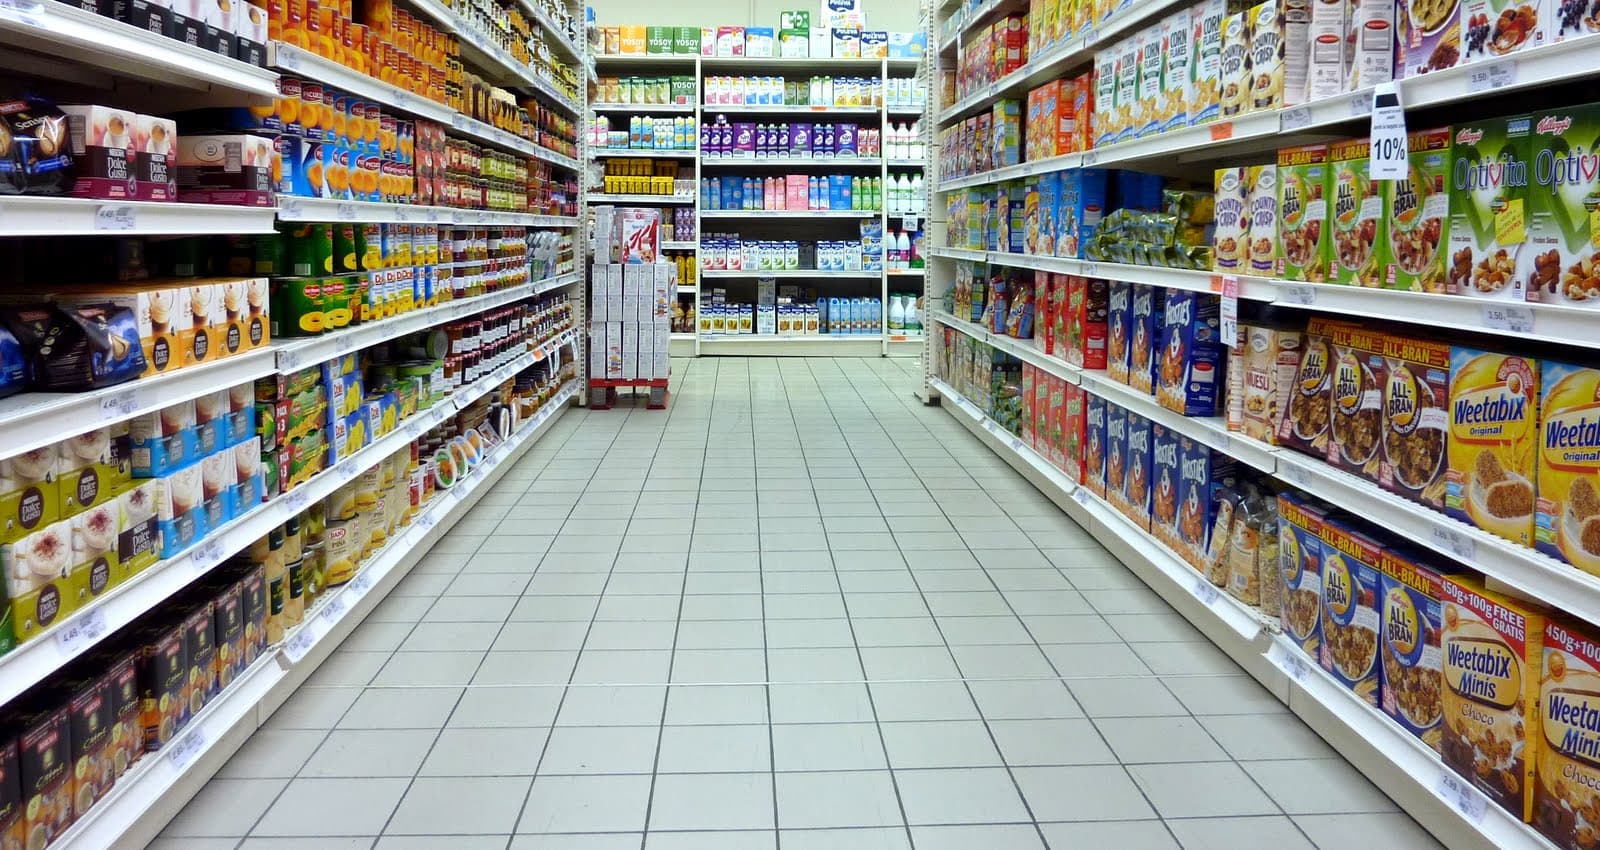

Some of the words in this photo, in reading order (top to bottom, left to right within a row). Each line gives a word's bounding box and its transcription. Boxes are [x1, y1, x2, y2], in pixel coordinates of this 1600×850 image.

[649, 38, 672, 46] YOSOY
[676, 38, 699, 46] YOSOY
[1170, 28, 1187, 44] CORN
[1144, 40, 1160, 56] CORN
[1170, 45, 1187, 57] FLAKES
[1255, 46, 1274, 66] CRISP
[1224, 57, 1240, 74] CRISP
[673, 81, 696, 89] YOSOY
[1374, 138, 1405, 161] 10%
[107, 157, 128, 170] Dolce
[150, 162, 168, 174] Dolce
[1535, 146, 1600, 196] Optiv
[108, 168, 128, 179] Gusto
[1454, 152, 1526, 199] Optivita
[1338, 184, 1355, 199] ALL-
[1336, 197, 1355, 219] BRAN
[1394, 194, 1417, 218] BRAN
[1305, 353, 1324, 368] ALL-
[1382, 341, 1430, 363] ALL-BRAN
[1338, 367, 1358, 384] ALL-
[1336, 382, 1358, 400] BRAN
[1391, 381, 1412, 399] ALL-
[1389, 398, 1413, 417] BRAN
[1454, 393, 1526, 425] Weetabix
[1470, 424, 1503, 437] Original
[80, 481, 97, 493] Dolce
[22, 502, 40, 516] Dolce
[22, 510, 40, 522] Gusto
[133, 529, 150, 547] Dolce
[1320, 527, 1362, 560] ALL-BRAN
[1327, 571, 1346, 590] ALL-
[1380, 557, 1431, 595] ALL-BRAN
[40, 598, 57, 613] Dolce
[1326, 586, 1347, 607] BRAN
[1441, 580, 1493, 619] 450g+100g
[1493, 604, 1524, 629] FREE
[1389, 605, 1412, 626] ALL-
[1388, 623, 1413, 645] BRAN
[1492, 618, 1525, 642] GRATIS
[1447, 643, 1511, 680] Weetabix
[1458, 671, 1496, 700] Minis
[1460, 703, 1494, 727] Choco
[1560, 728, 1600, 760] Mini
